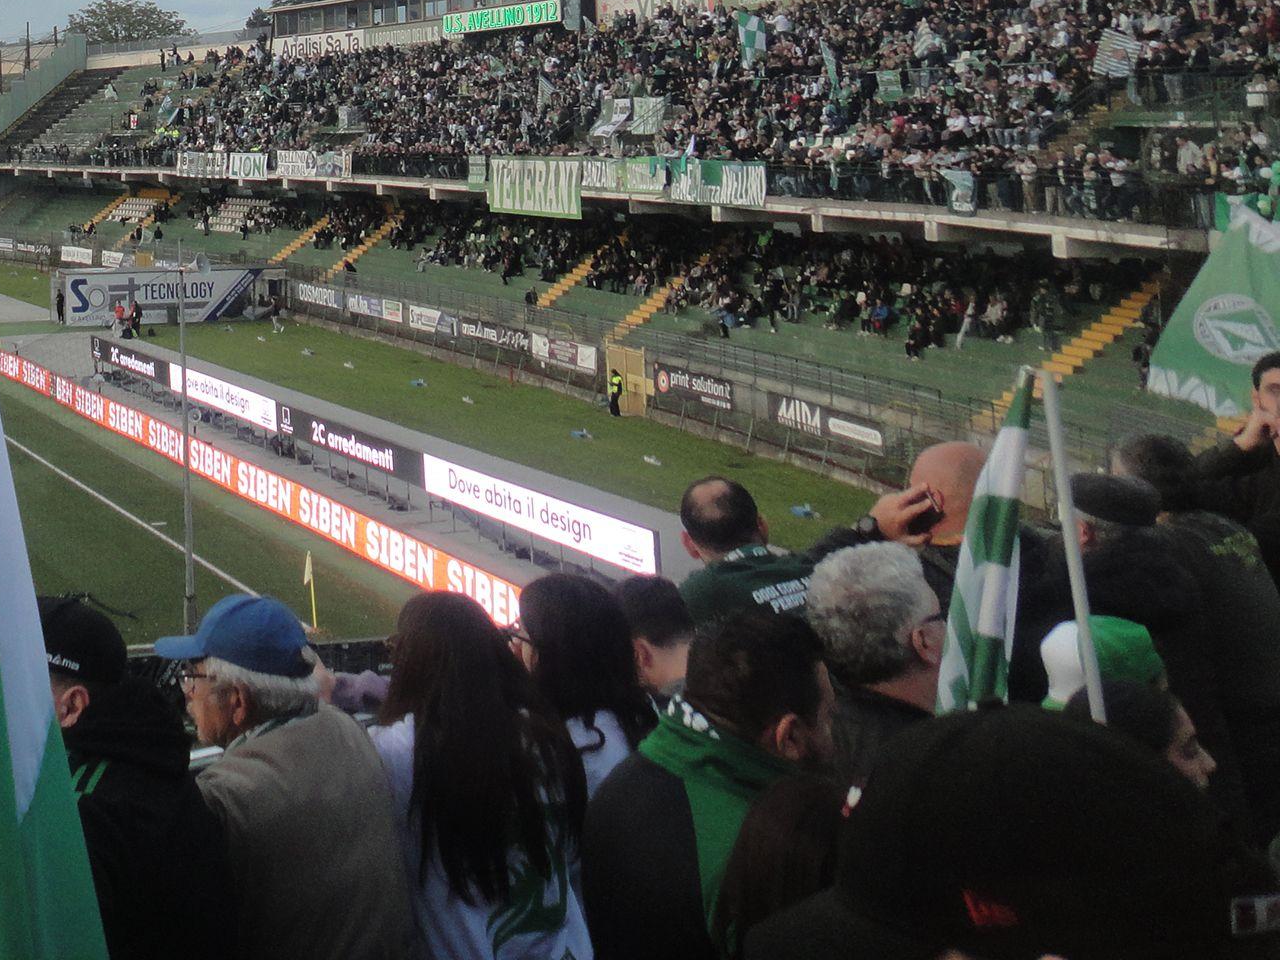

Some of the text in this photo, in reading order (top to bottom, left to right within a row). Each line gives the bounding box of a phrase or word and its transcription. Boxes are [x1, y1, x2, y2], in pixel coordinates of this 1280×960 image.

[443, 2, 557, 33] U.S. AVELLINO 1912
[282, 35, 322, 58] Analisi
[491, 159, 580, 215] VETERANI
[721, 165, 767, 207] AVELLINO
[143, 281, 215, 300] TECNOLOGY
[298, 283, 337, 308] COSMOPOL
[22, 361, 46, 391] SIBEN
[110, 346, 155, 378] 2C arredamenti
[669, 370, 689, 390] print
[75, 385, 104, 420] SIBEN
[200, 378, 218, 399] abita
[225, 387, 250, 414] design
[108, 400, 143, 439] SIBEN
[148, 418, 184, 461] SIBEN
[311, 420, 394, 471] 2C arredamenti
[190, 439, 232, 486] SIBEN
[237, 461, 291, 515] SIBEN
[448, 468, 592, 544] Dove abita il design
[299, 487, 357, 548] SIBEN
[365, 521, 435, 587] SIBEN
